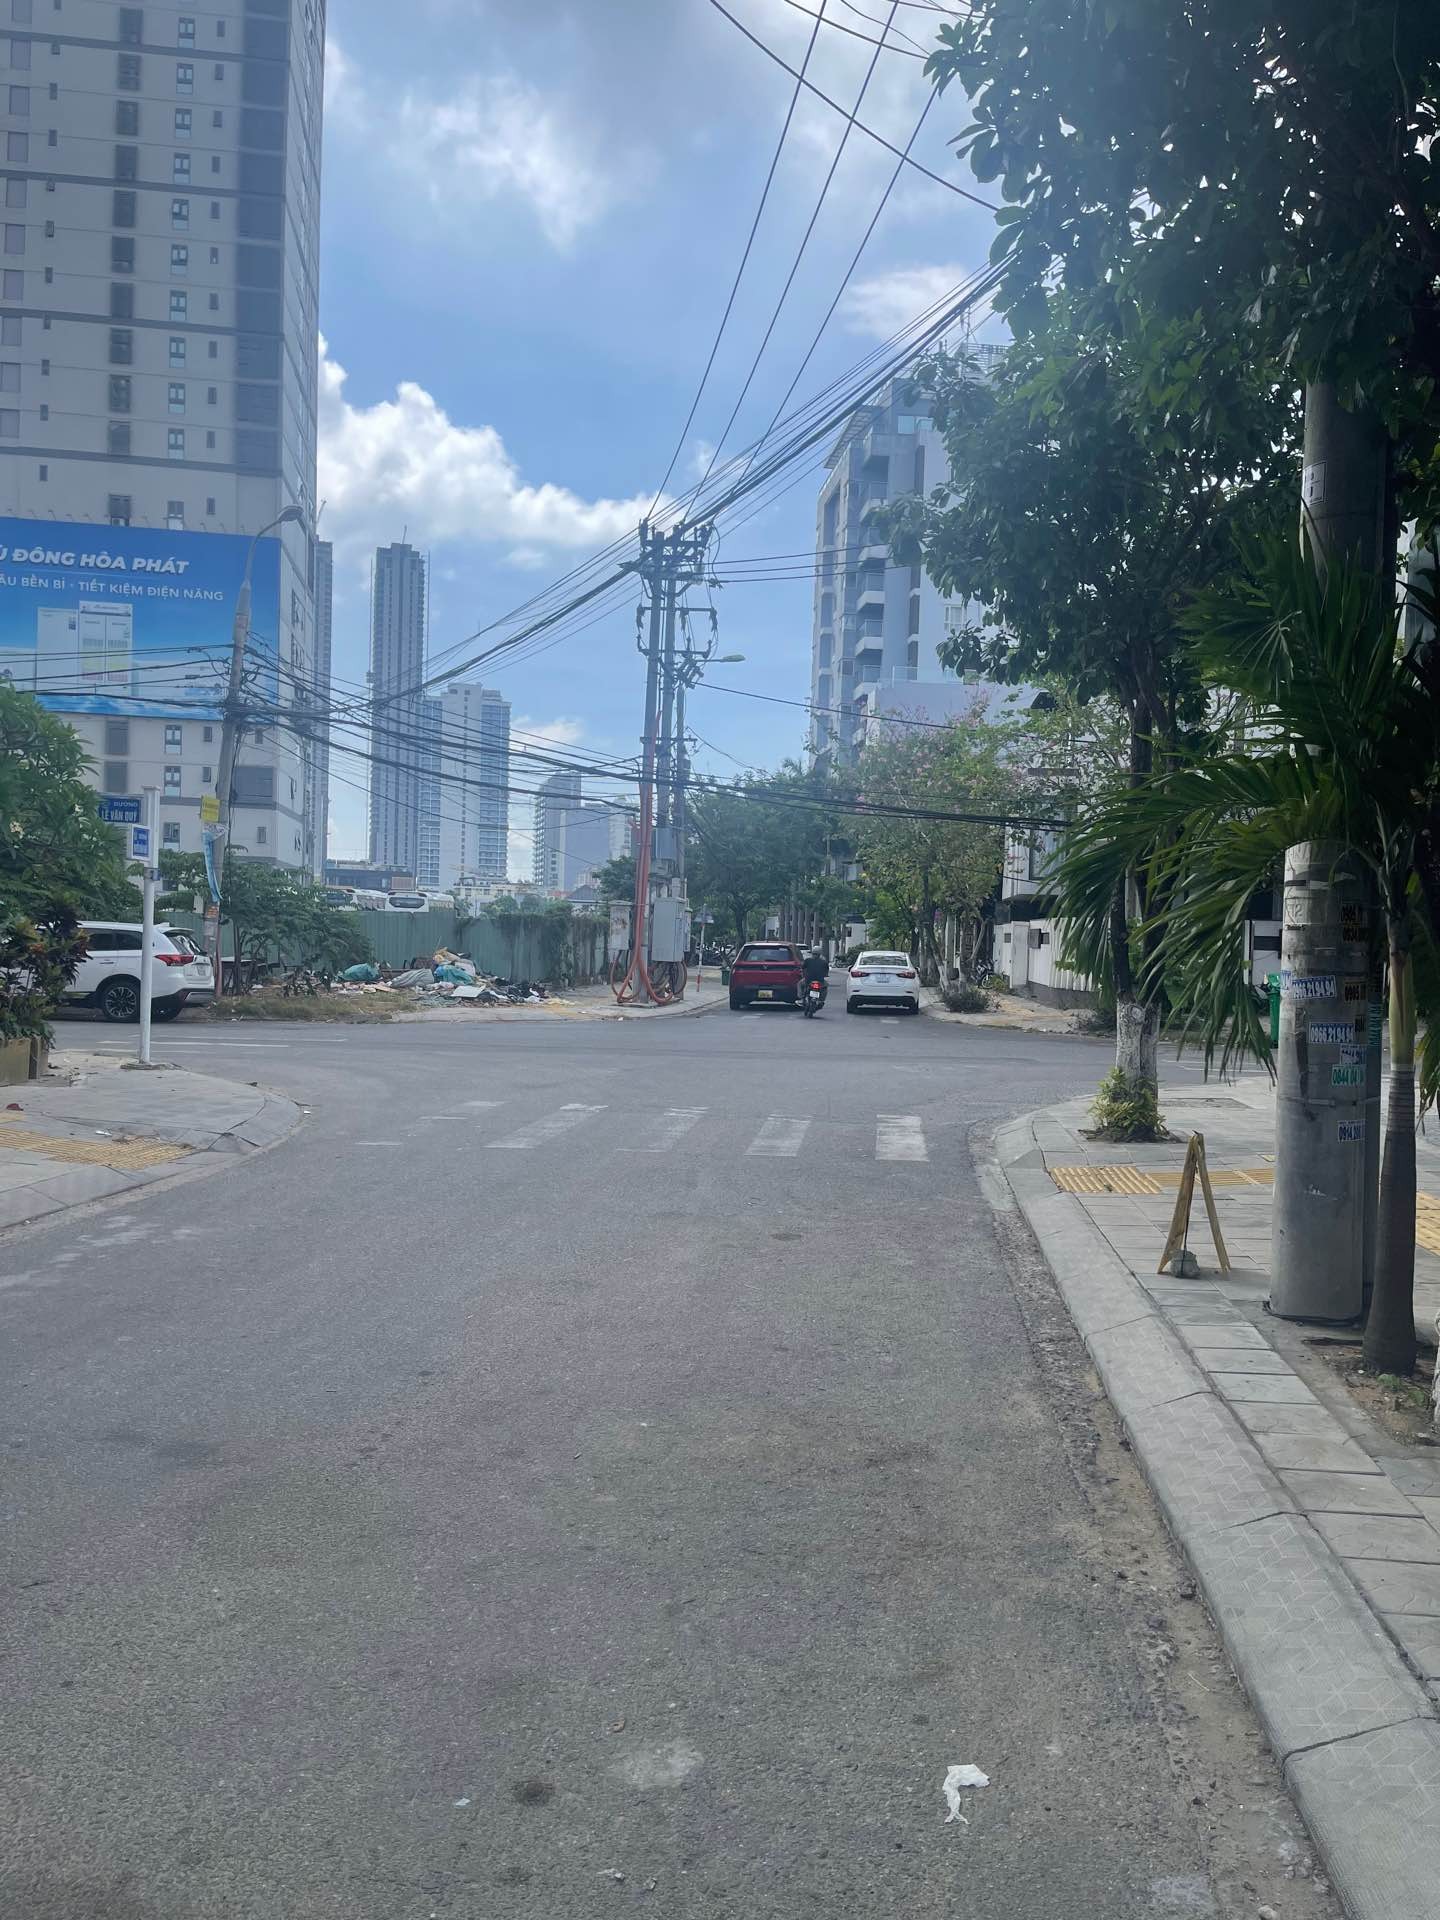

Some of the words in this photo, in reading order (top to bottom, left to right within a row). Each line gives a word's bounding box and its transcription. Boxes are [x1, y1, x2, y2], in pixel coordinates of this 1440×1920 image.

[12, 546, 76, 566] ĐÔNG
[80, 551, 126, 570] HÒA
[132, 556, 190, 574] PHÁT
[109, 582, 143, 597] KIỆM
[147, 585, 179, 600] ĐIỆN
[183, 588, 224, 601] NĂNG
